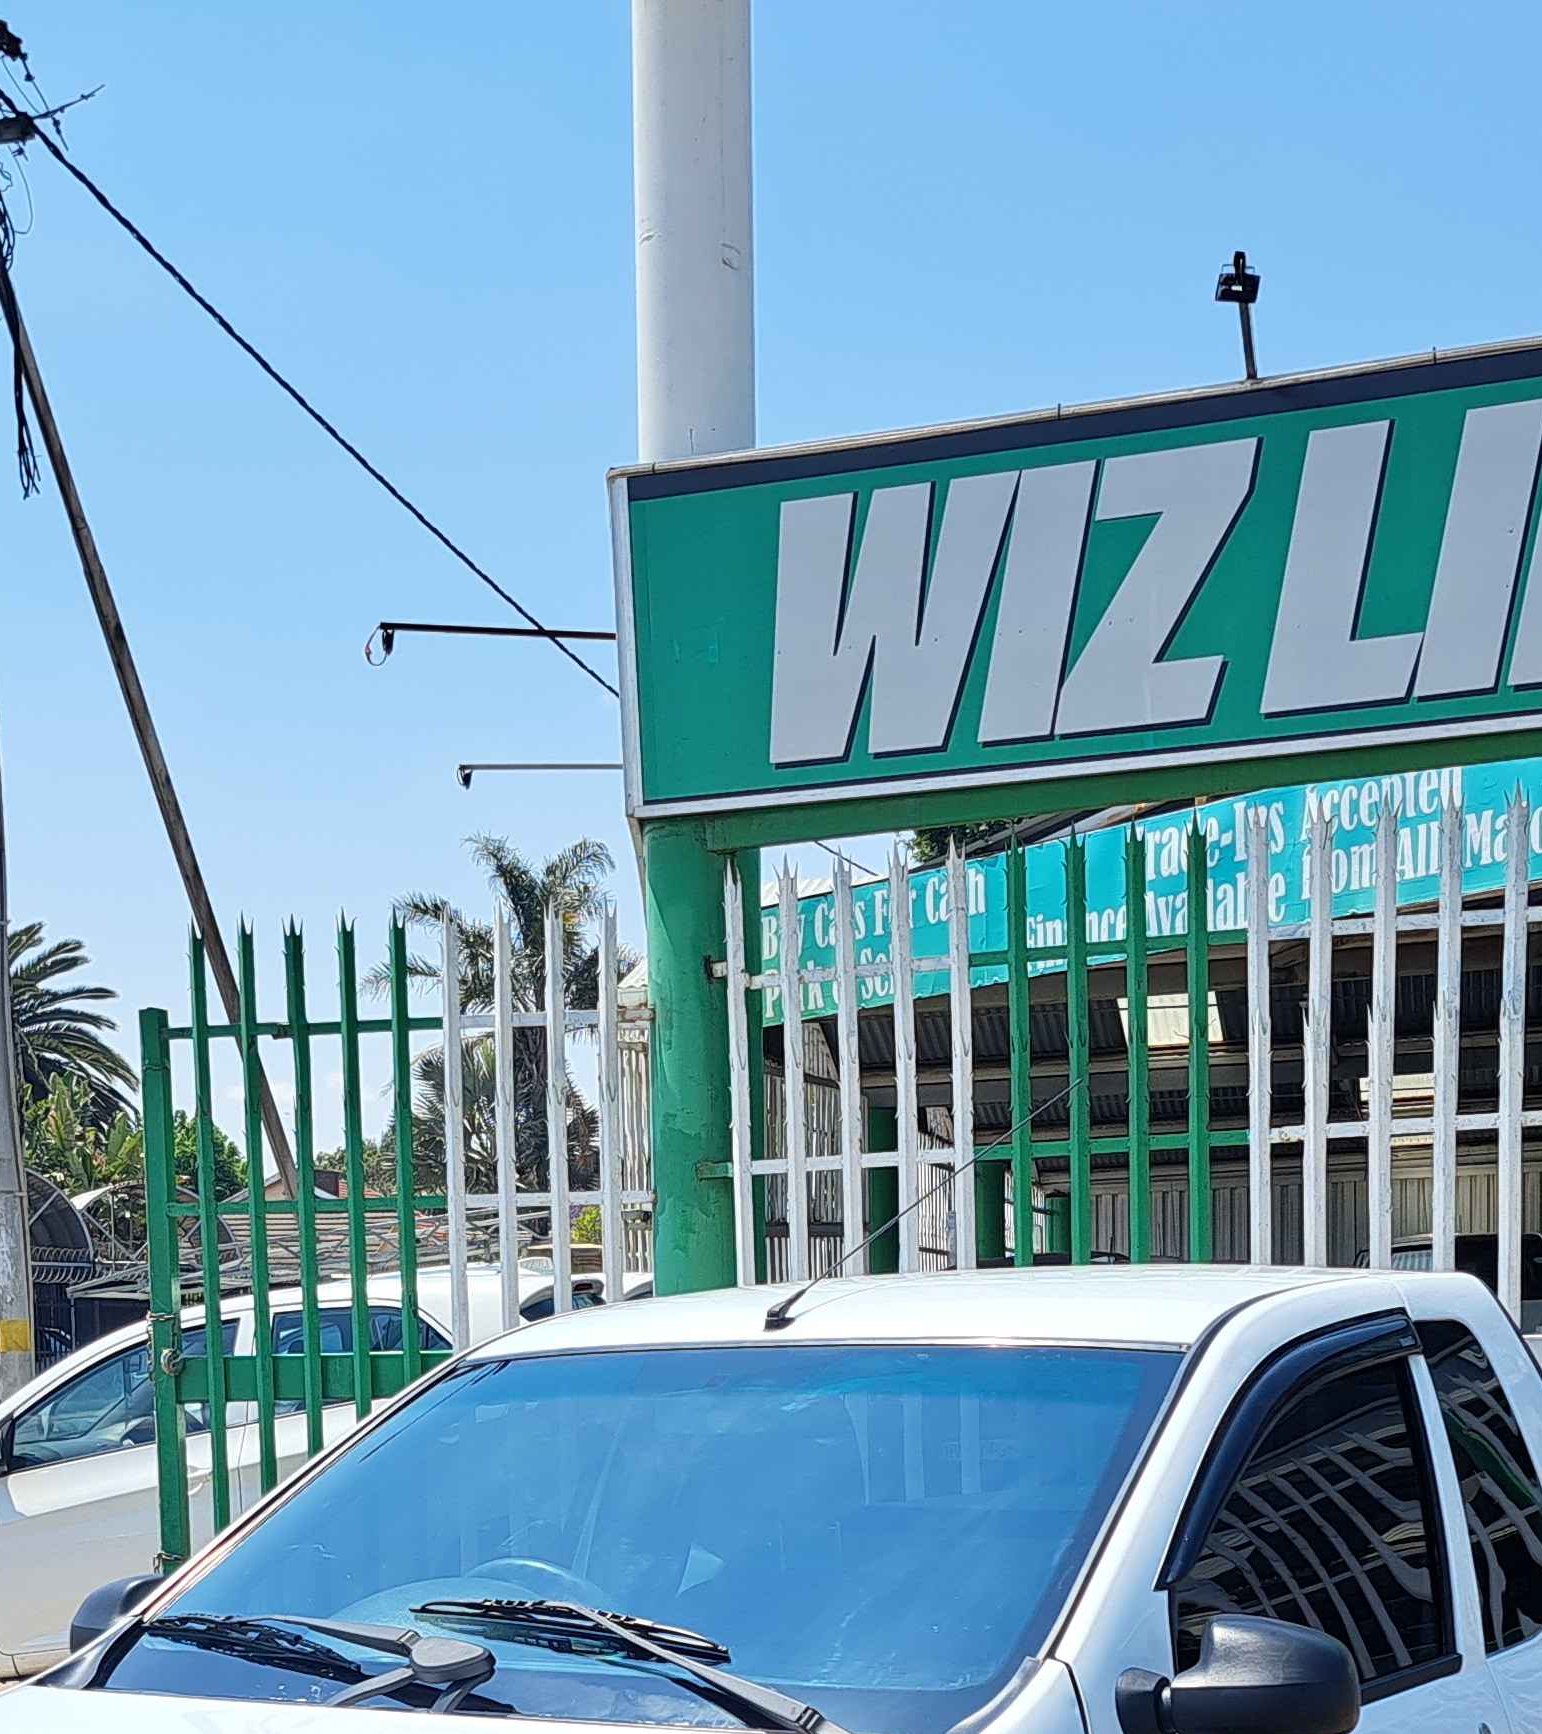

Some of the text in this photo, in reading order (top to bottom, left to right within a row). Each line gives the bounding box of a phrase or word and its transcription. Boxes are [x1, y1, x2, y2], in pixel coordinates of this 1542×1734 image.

[768, 436, 1263, 769] WIZ
[873, 888, 917, 936] Fr
[925, 868, 987, 924] Cah
[1301, 843, 1378, 900] fom
